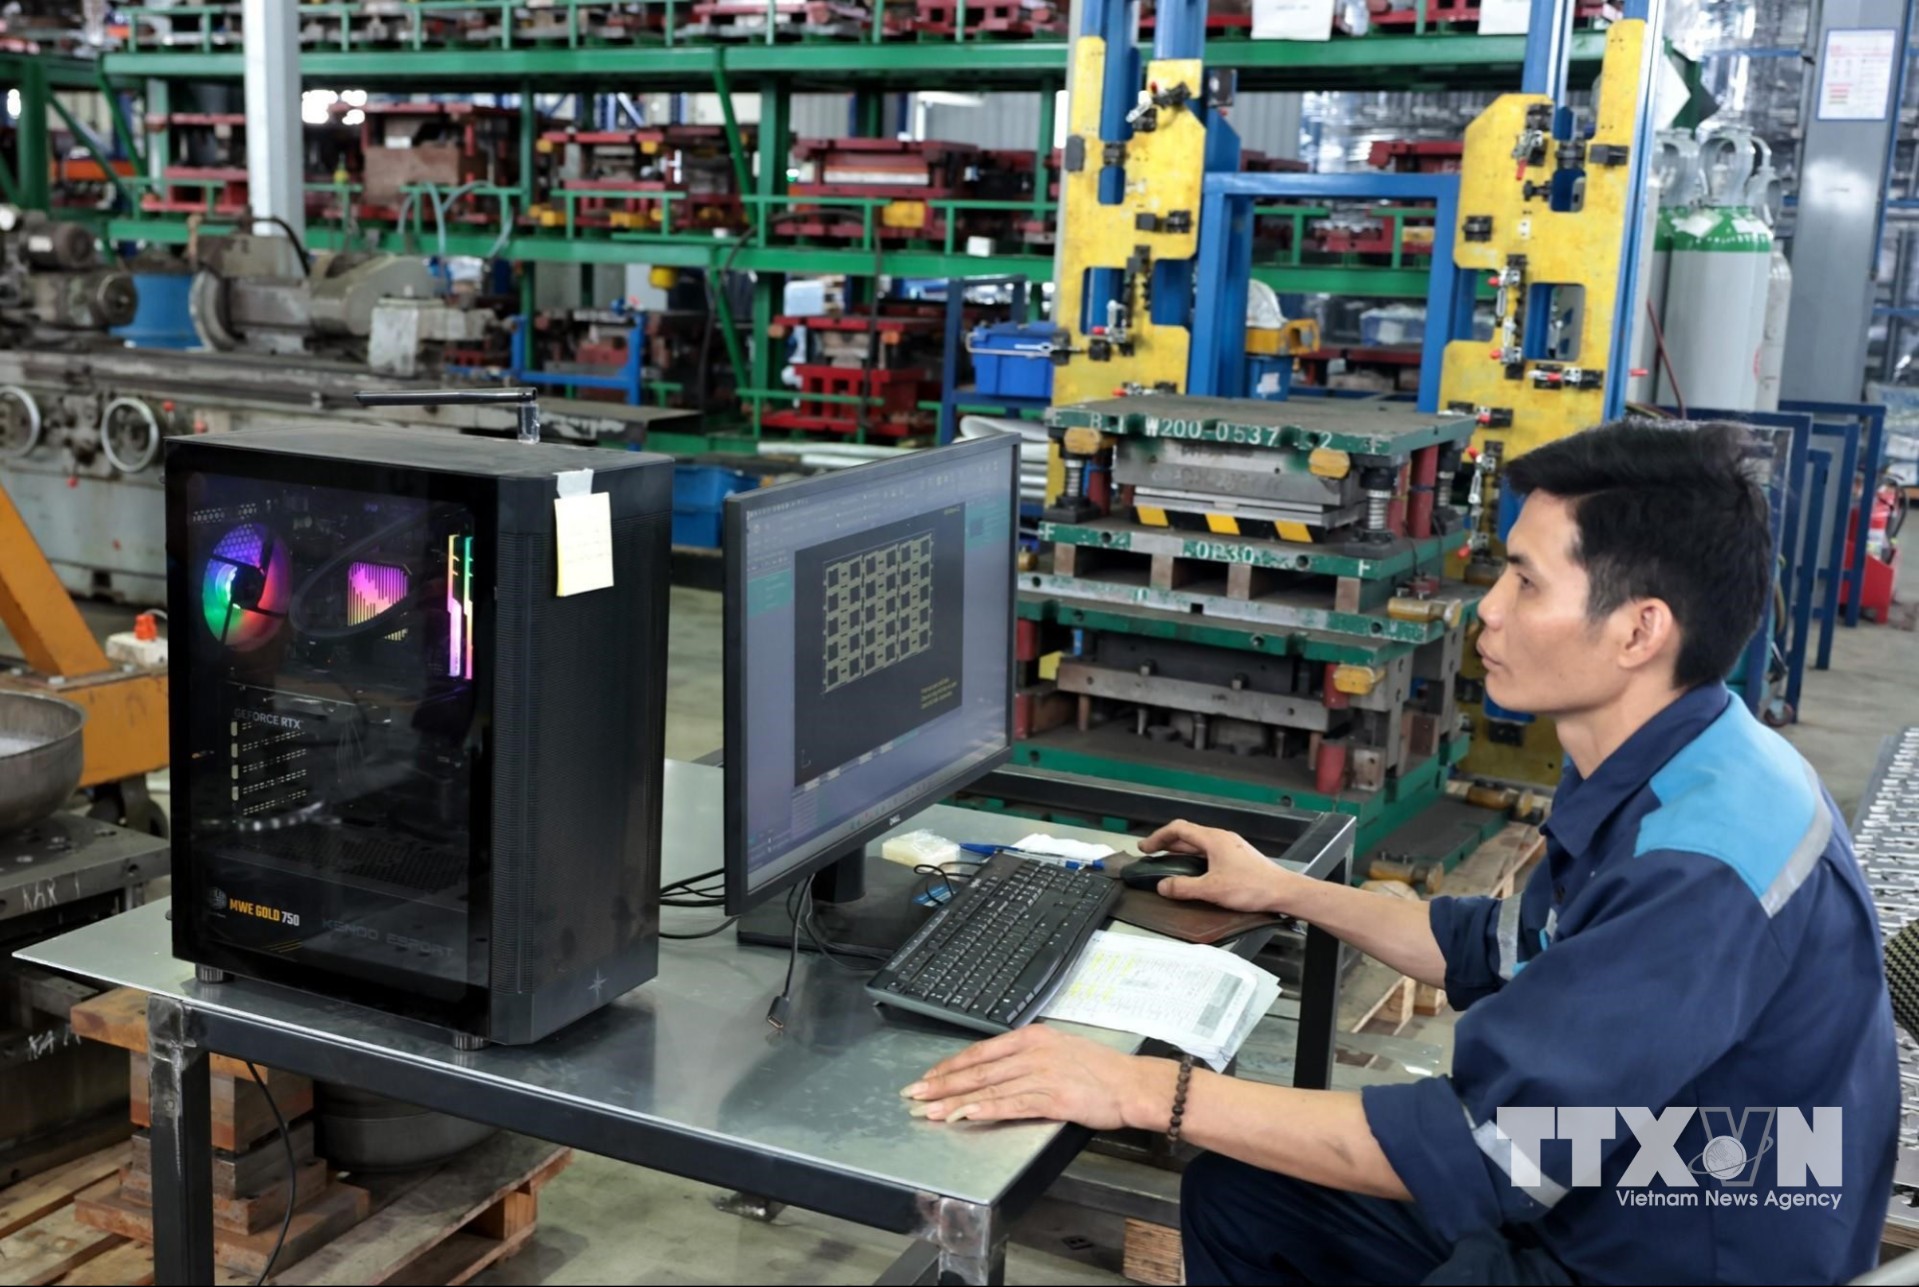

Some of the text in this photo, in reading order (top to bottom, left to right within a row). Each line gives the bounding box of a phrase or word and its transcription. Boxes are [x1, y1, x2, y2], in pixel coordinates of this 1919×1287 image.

[233, 707, 301, 730] GEFORCE RTX
[229, 898, 254, 916] MWE
[255, 904, 280, 922] GOLD
[281, 911, 300, 927] 750
